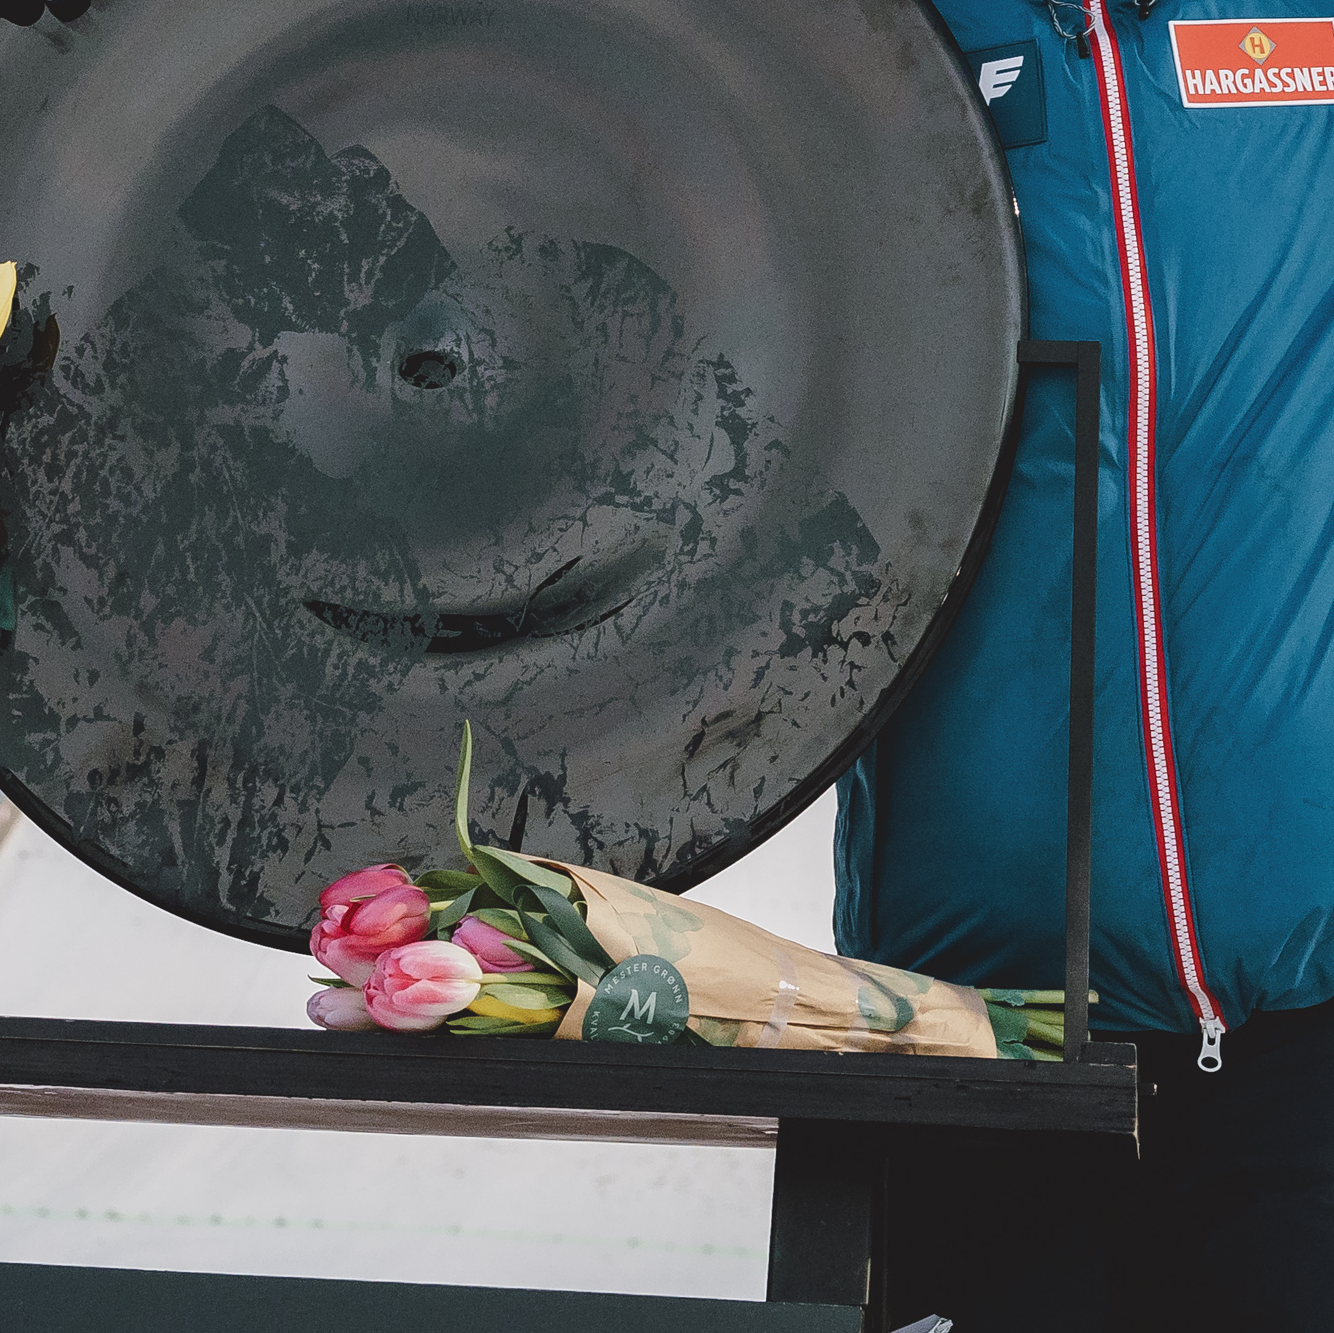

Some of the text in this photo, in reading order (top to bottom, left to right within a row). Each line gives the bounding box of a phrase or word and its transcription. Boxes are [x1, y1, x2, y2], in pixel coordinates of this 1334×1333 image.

[1249, 36, 1266, 55] H
[604, 962, 684, 1004] MESTER GRØNN
[619, 988, 657, 1025] M
[590, 1011, 601, 1041] KVAL
